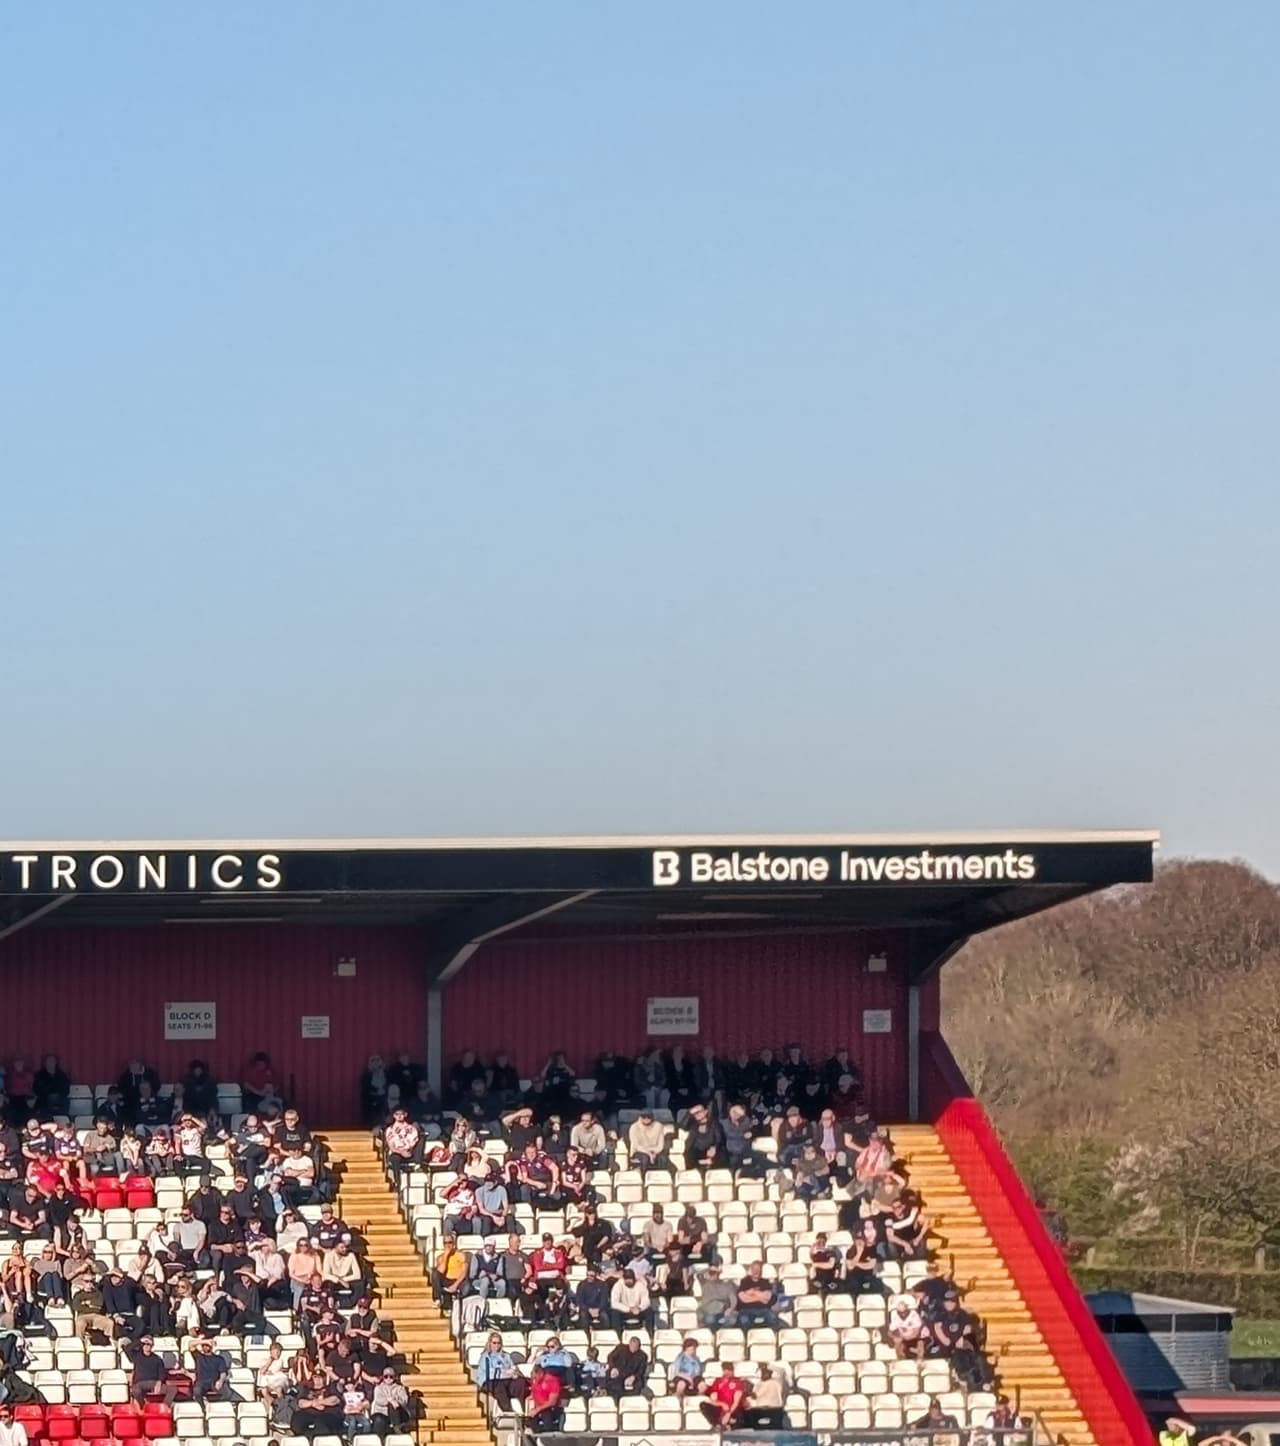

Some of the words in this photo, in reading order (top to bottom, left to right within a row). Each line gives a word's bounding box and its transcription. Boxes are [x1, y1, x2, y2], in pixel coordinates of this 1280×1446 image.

[690, 851, 829, 883] Balstone
[840, 848, 1036, 882] Investments
[169, 1012, 201, 1021] BLOCK
[203, 1012, 212, 1021] D
[167, 1023, 191, 1031] SEATS
